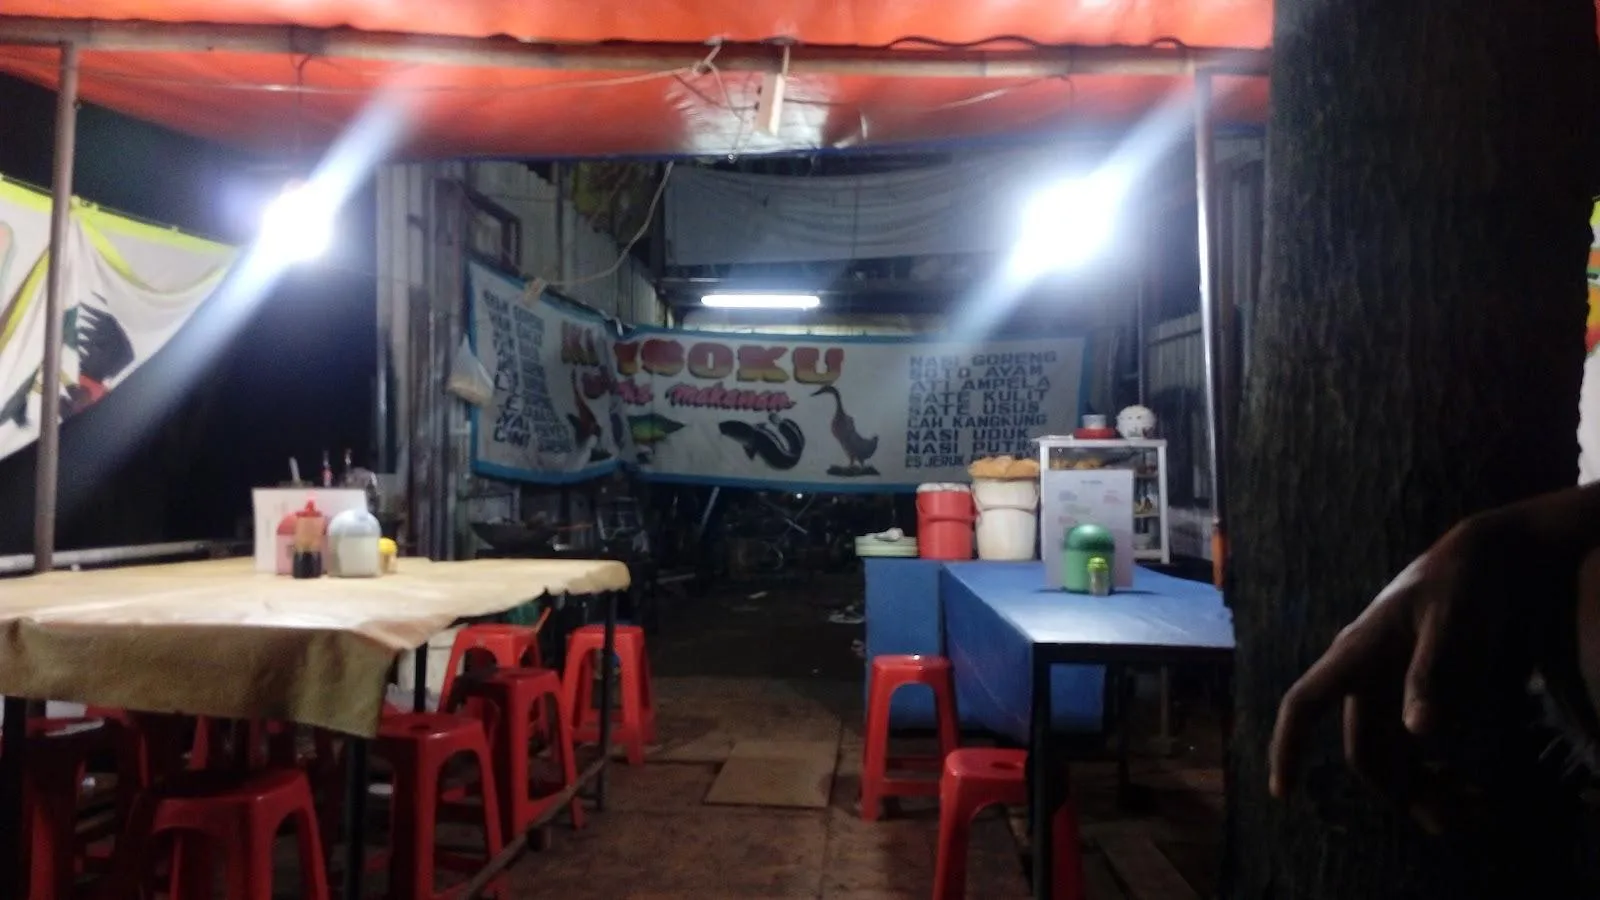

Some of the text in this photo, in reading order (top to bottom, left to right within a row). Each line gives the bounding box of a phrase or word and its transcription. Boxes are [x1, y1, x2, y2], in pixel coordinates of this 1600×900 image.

[972, 350, 1057, 365] GORENG
[984, 365, 1043, 378] AYAM
[911, 377, 1050, 392] ATI AMPELA
[908, 389, 1047, 404] SATE KULIT
[907, 401, 1040, 416] SATE USUS
[952, 414, 1048, 428] KANGKUNG
[906, 428, 1029, 441] NASI UDUK
[905, 442, 958, 454] NASI
